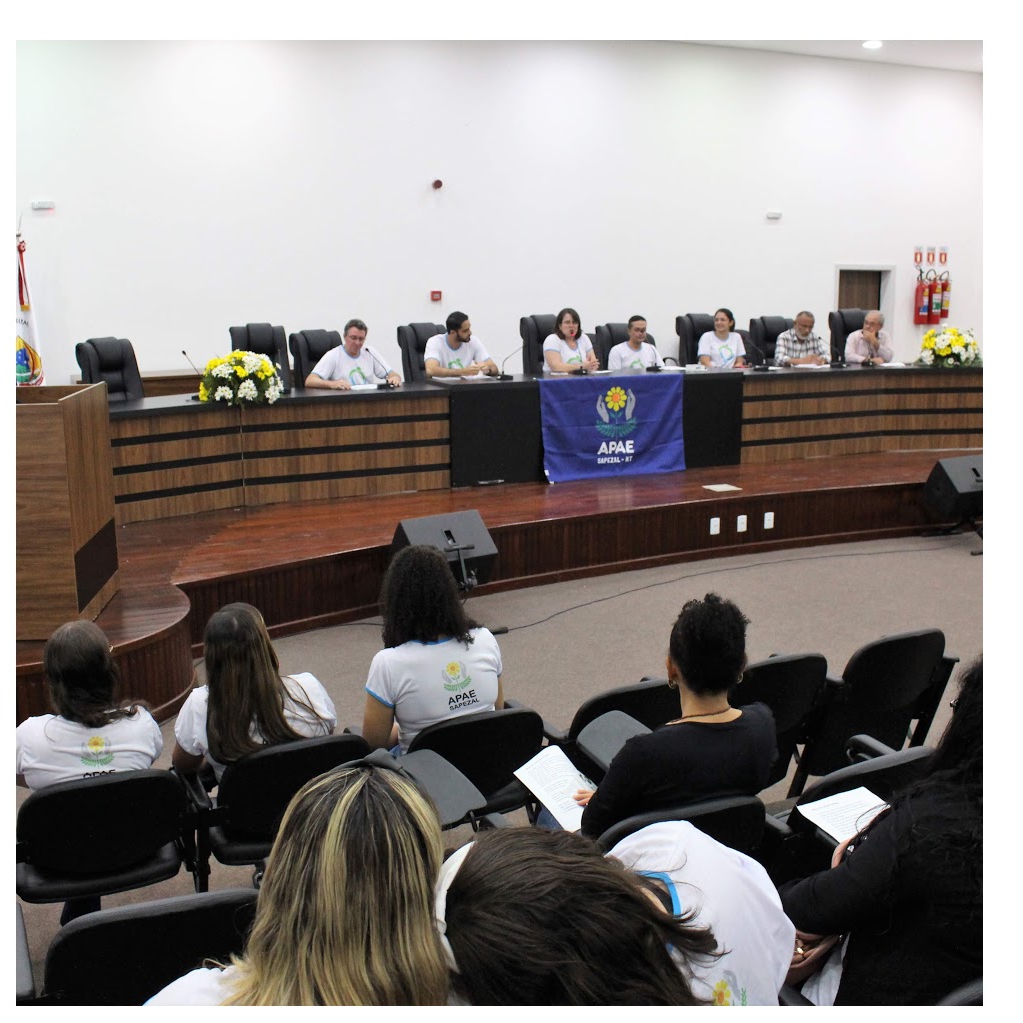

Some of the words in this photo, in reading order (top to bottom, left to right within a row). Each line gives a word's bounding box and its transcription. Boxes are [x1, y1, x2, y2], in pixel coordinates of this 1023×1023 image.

[597, 440, 635, 455] APAE
[448, 689, 477, 705] APAE
[449, 698, 480, 711] SAPEZAL
